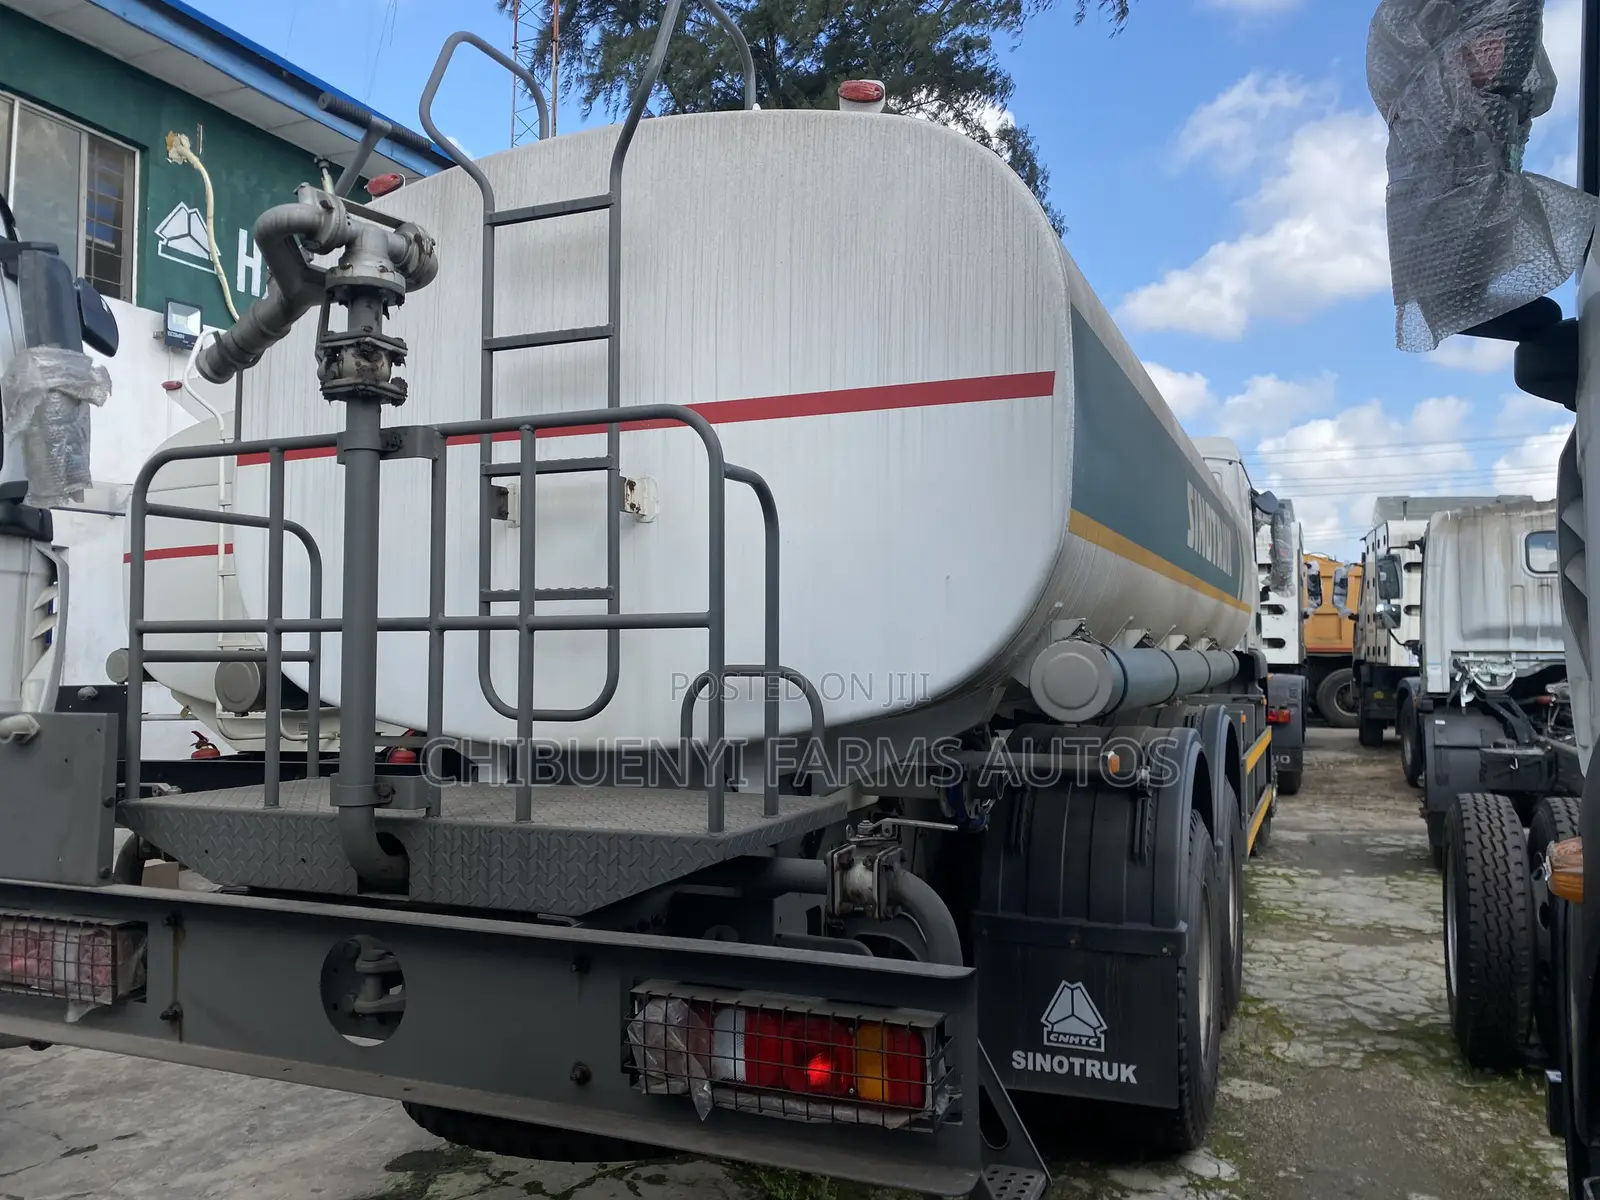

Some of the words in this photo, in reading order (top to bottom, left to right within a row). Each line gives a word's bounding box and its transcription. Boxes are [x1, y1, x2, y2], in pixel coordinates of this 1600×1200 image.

[237, 228, 268, 299] H
[1049, 1033, 1098, 1046] CNHTC
[1011, 1050, 1138, 1084] SINOTRUK
